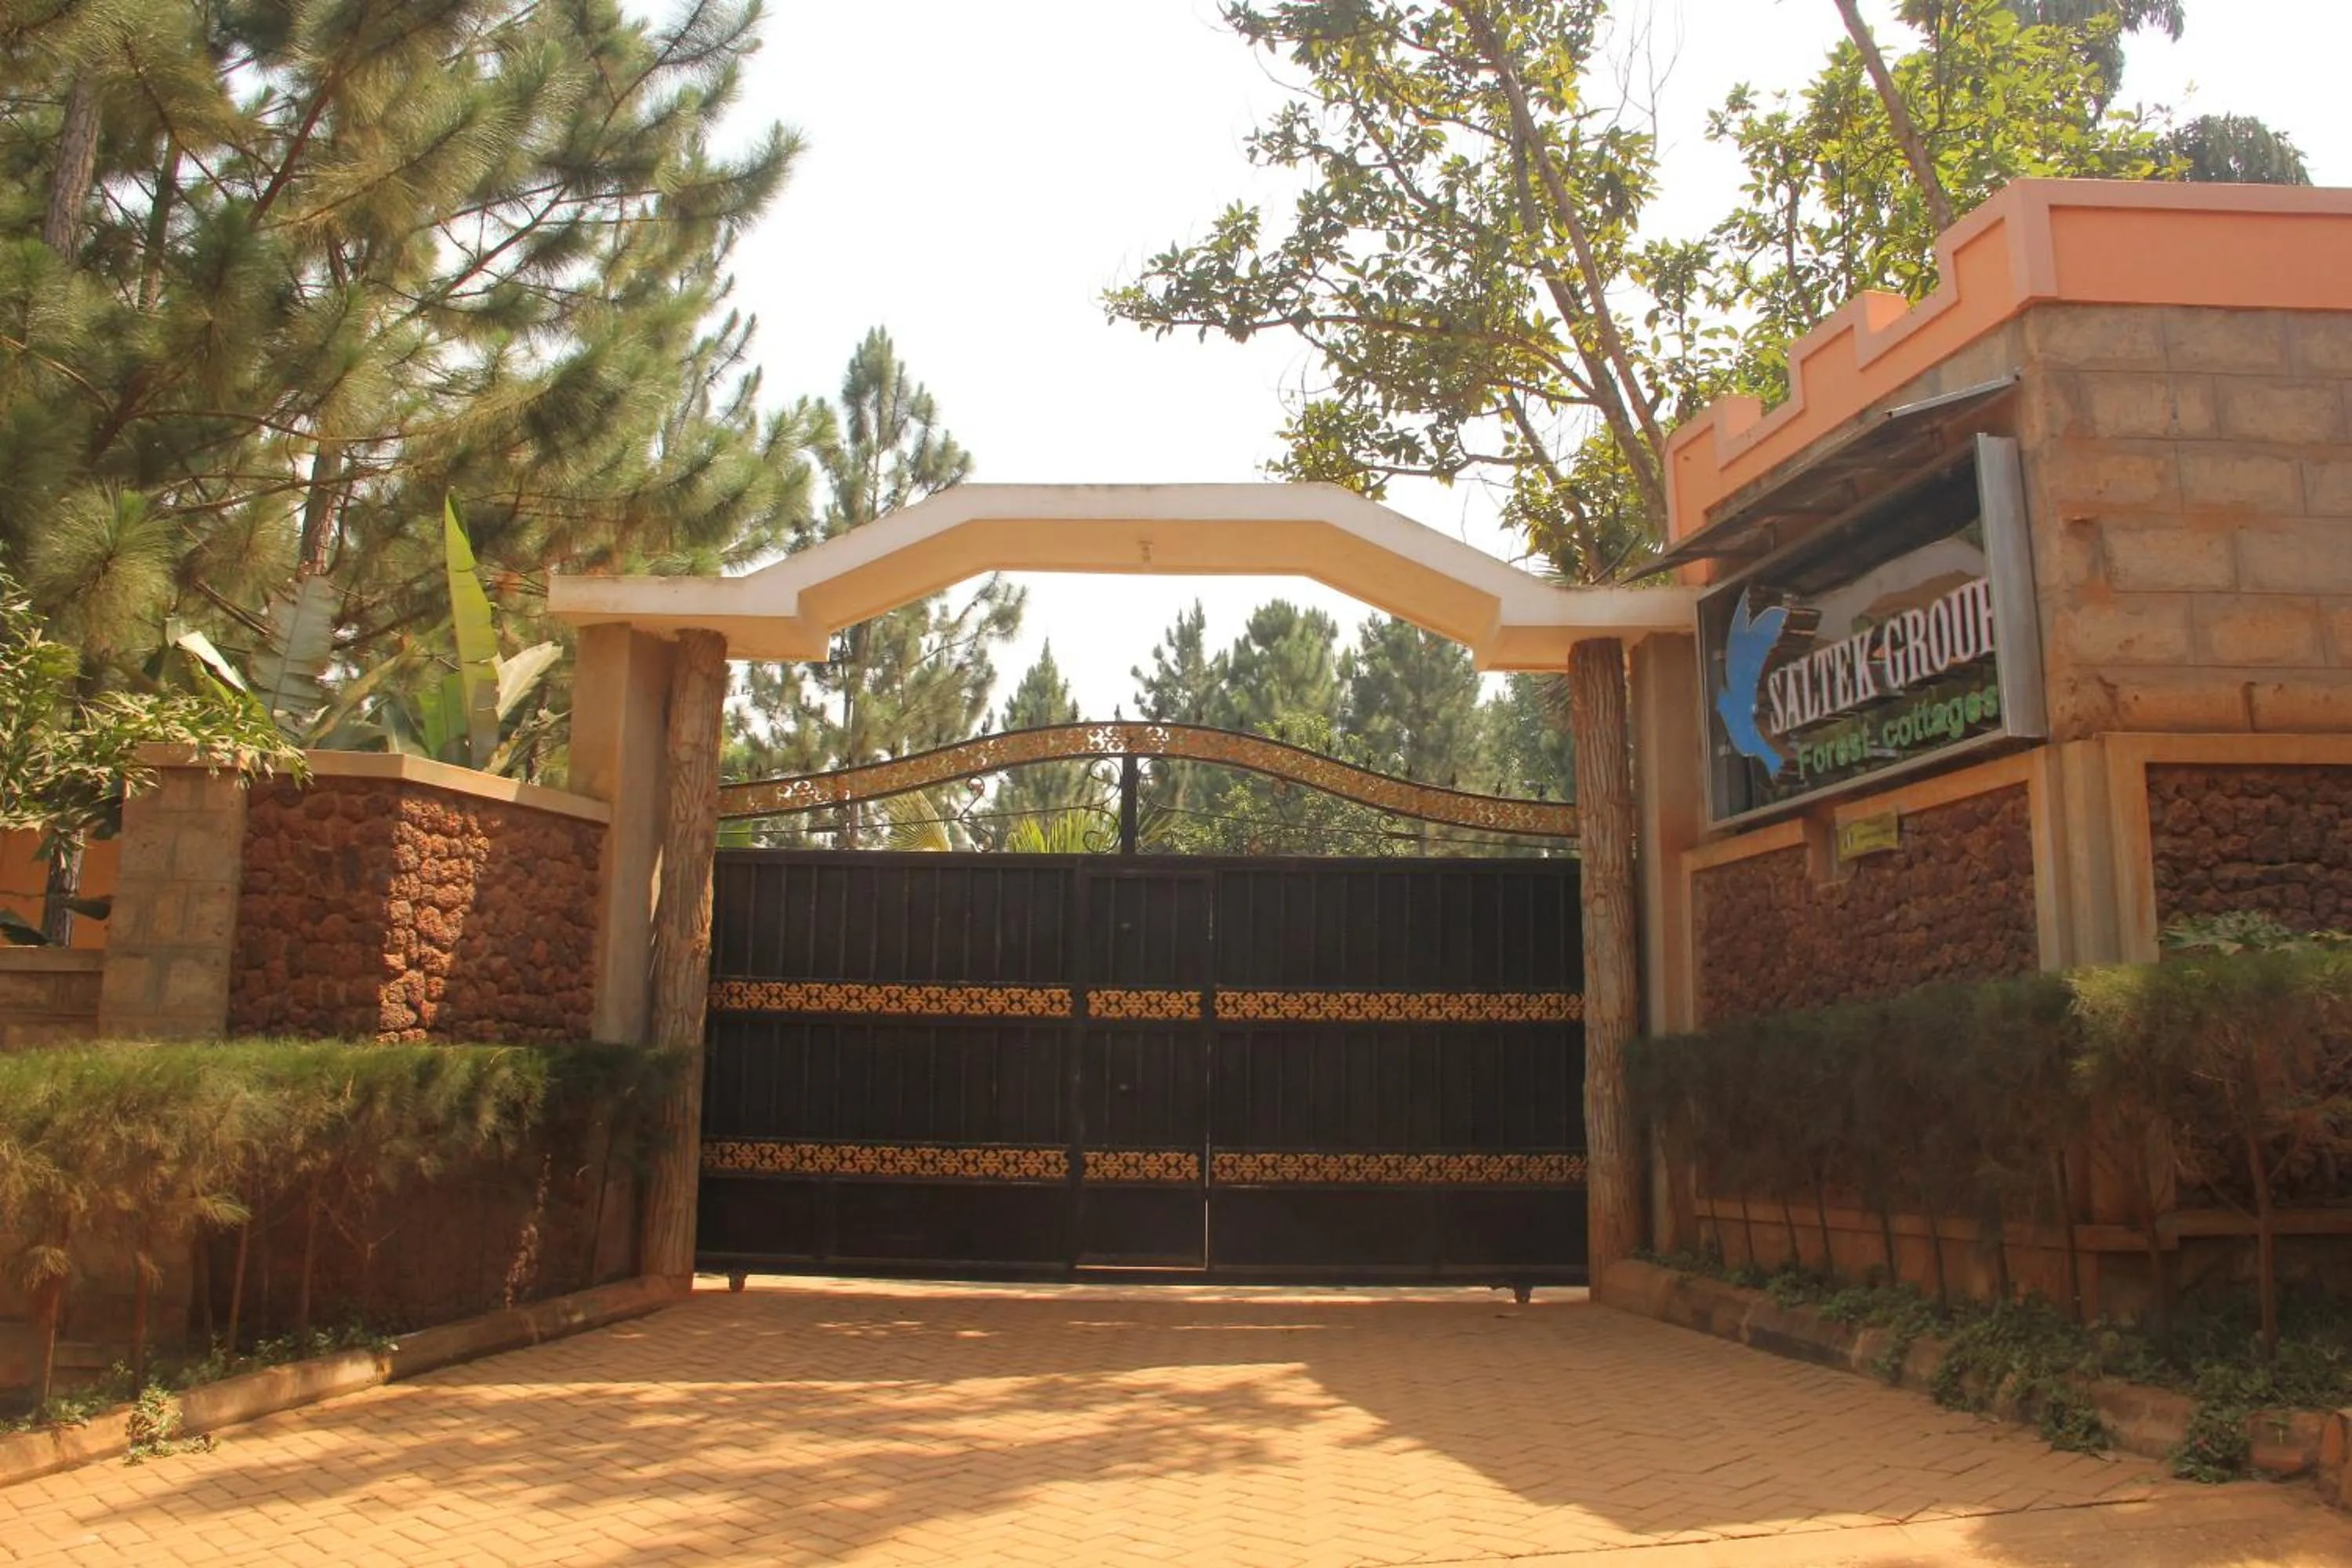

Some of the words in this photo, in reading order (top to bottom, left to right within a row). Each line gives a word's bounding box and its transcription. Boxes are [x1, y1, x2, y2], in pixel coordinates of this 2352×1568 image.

[1768, 626, 1878, 735] SALTEK
[1798, 723, 1871, 779] Forest
[1882, 684, 1998, 749] cottages
